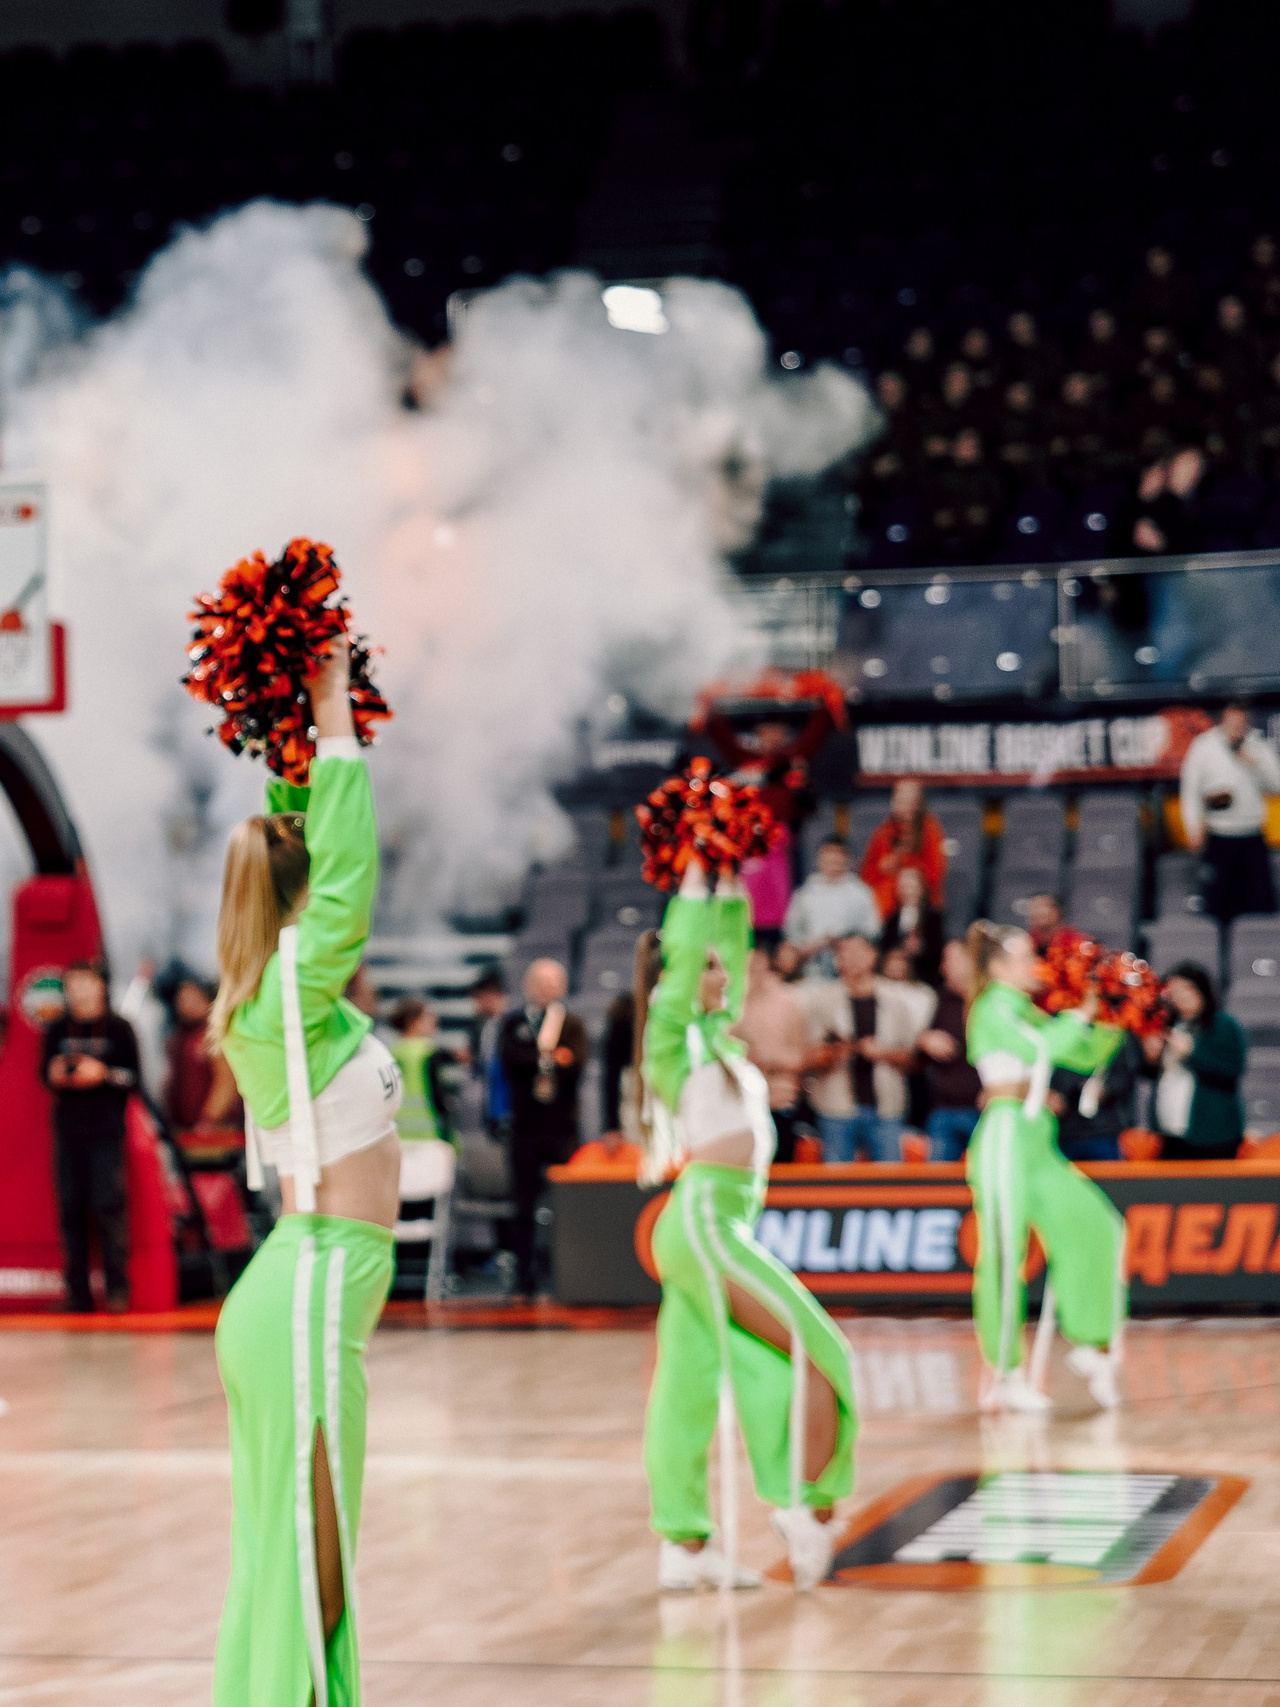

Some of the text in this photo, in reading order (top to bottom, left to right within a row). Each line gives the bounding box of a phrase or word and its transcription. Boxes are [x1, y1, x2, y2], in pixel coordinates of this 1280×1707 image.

[857, 714, 1169, 773] WINLINE BASKET CUP
[756, 1209, 959, 1273] NLINE
